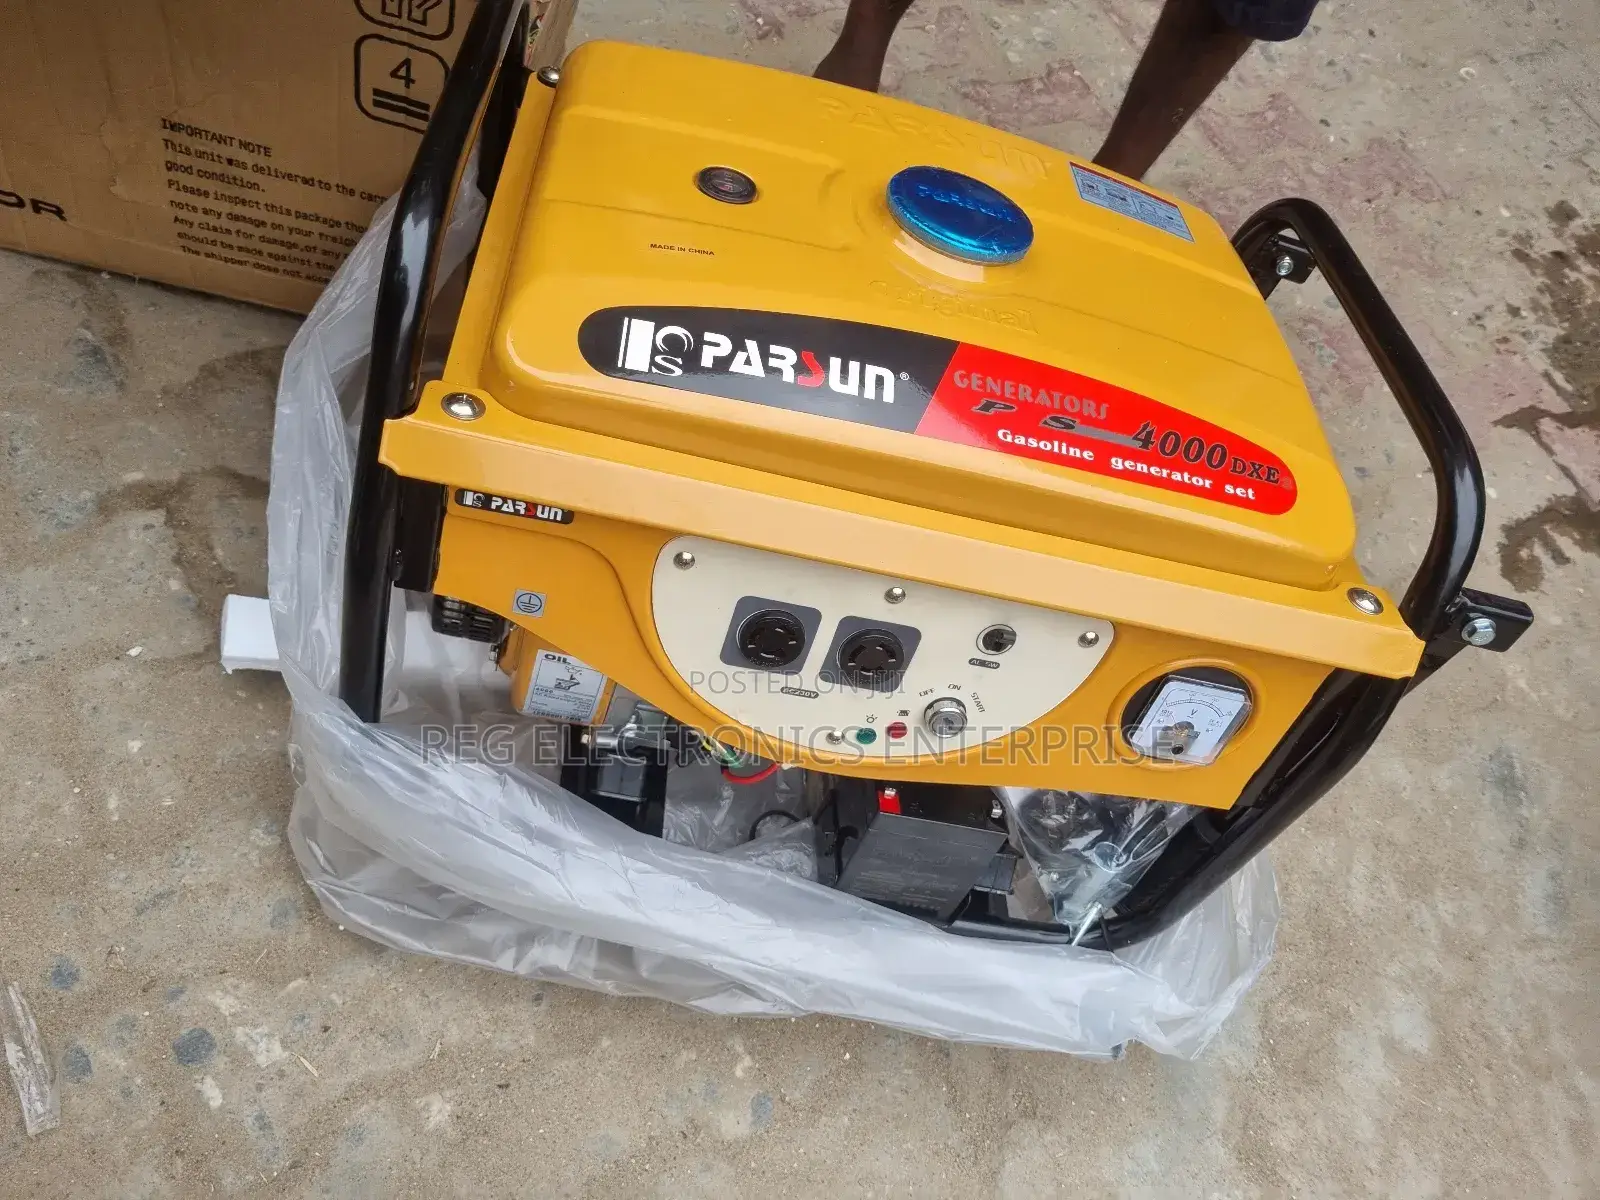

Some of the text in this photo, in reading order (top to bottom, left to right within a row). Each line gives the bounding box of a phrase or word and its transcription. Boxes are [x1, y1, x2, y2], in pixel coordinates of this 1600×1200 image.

[389, 57, 416, 89] 4
[161, 118, 273, 157] IMPORTANT NOTE
[162, 138, 192, 156] This
[194, 149, 223, 164] unit
[226, 157, 248, 170] was
[251, 163, 316, 187] delivered
[317, 179, 332, 191] to
[335, 183, 356, 197] the
[165, 160, 266, 193] good condition.
[167, 179, 210, 198] Please
[213, 190, 262, 210] inspect
[264, 202, 292, 217] this
[294, 210, 343, 228] package
[169, 200, 198, 213] note
[201, 207, 222, 220] any
[226, 212, 268, 228] damage
[271, 222, 285, 232] on
[287, 226, 314, 238] your
[173, 215, 194, 229] Any
[198, 222, 232, 236] claim
[235, 229, 255, 241] for
[321, 248, 341, 259] any
[177, 231, 217, 247] should
[220, 240, 234, 251] be
[237, 245, 265, 257] made
[267, 252, 312, 268] against
[649, 243, 675, 251] MADE
[688, 247, 715, 257] CHINA
[180, 245, 201, 256] The
[204, 252, 249, 267] shipper
[953, 369, 1109, 420] GENERATORS
[971, 399, 1017, 415] P
[1131, 420, 1228, 470] 4000
[1229, 456, 1282, 486] DXE
[997, 428, 1257, 501] Gasoline generator set
[490, 496, 563, 521] PARSUN
[544, 653, 572, 665] OIL
[919, 687, 935, 697] OFF
[947, 683, 962, 691] ON
[971, 692, 986, 713] START
